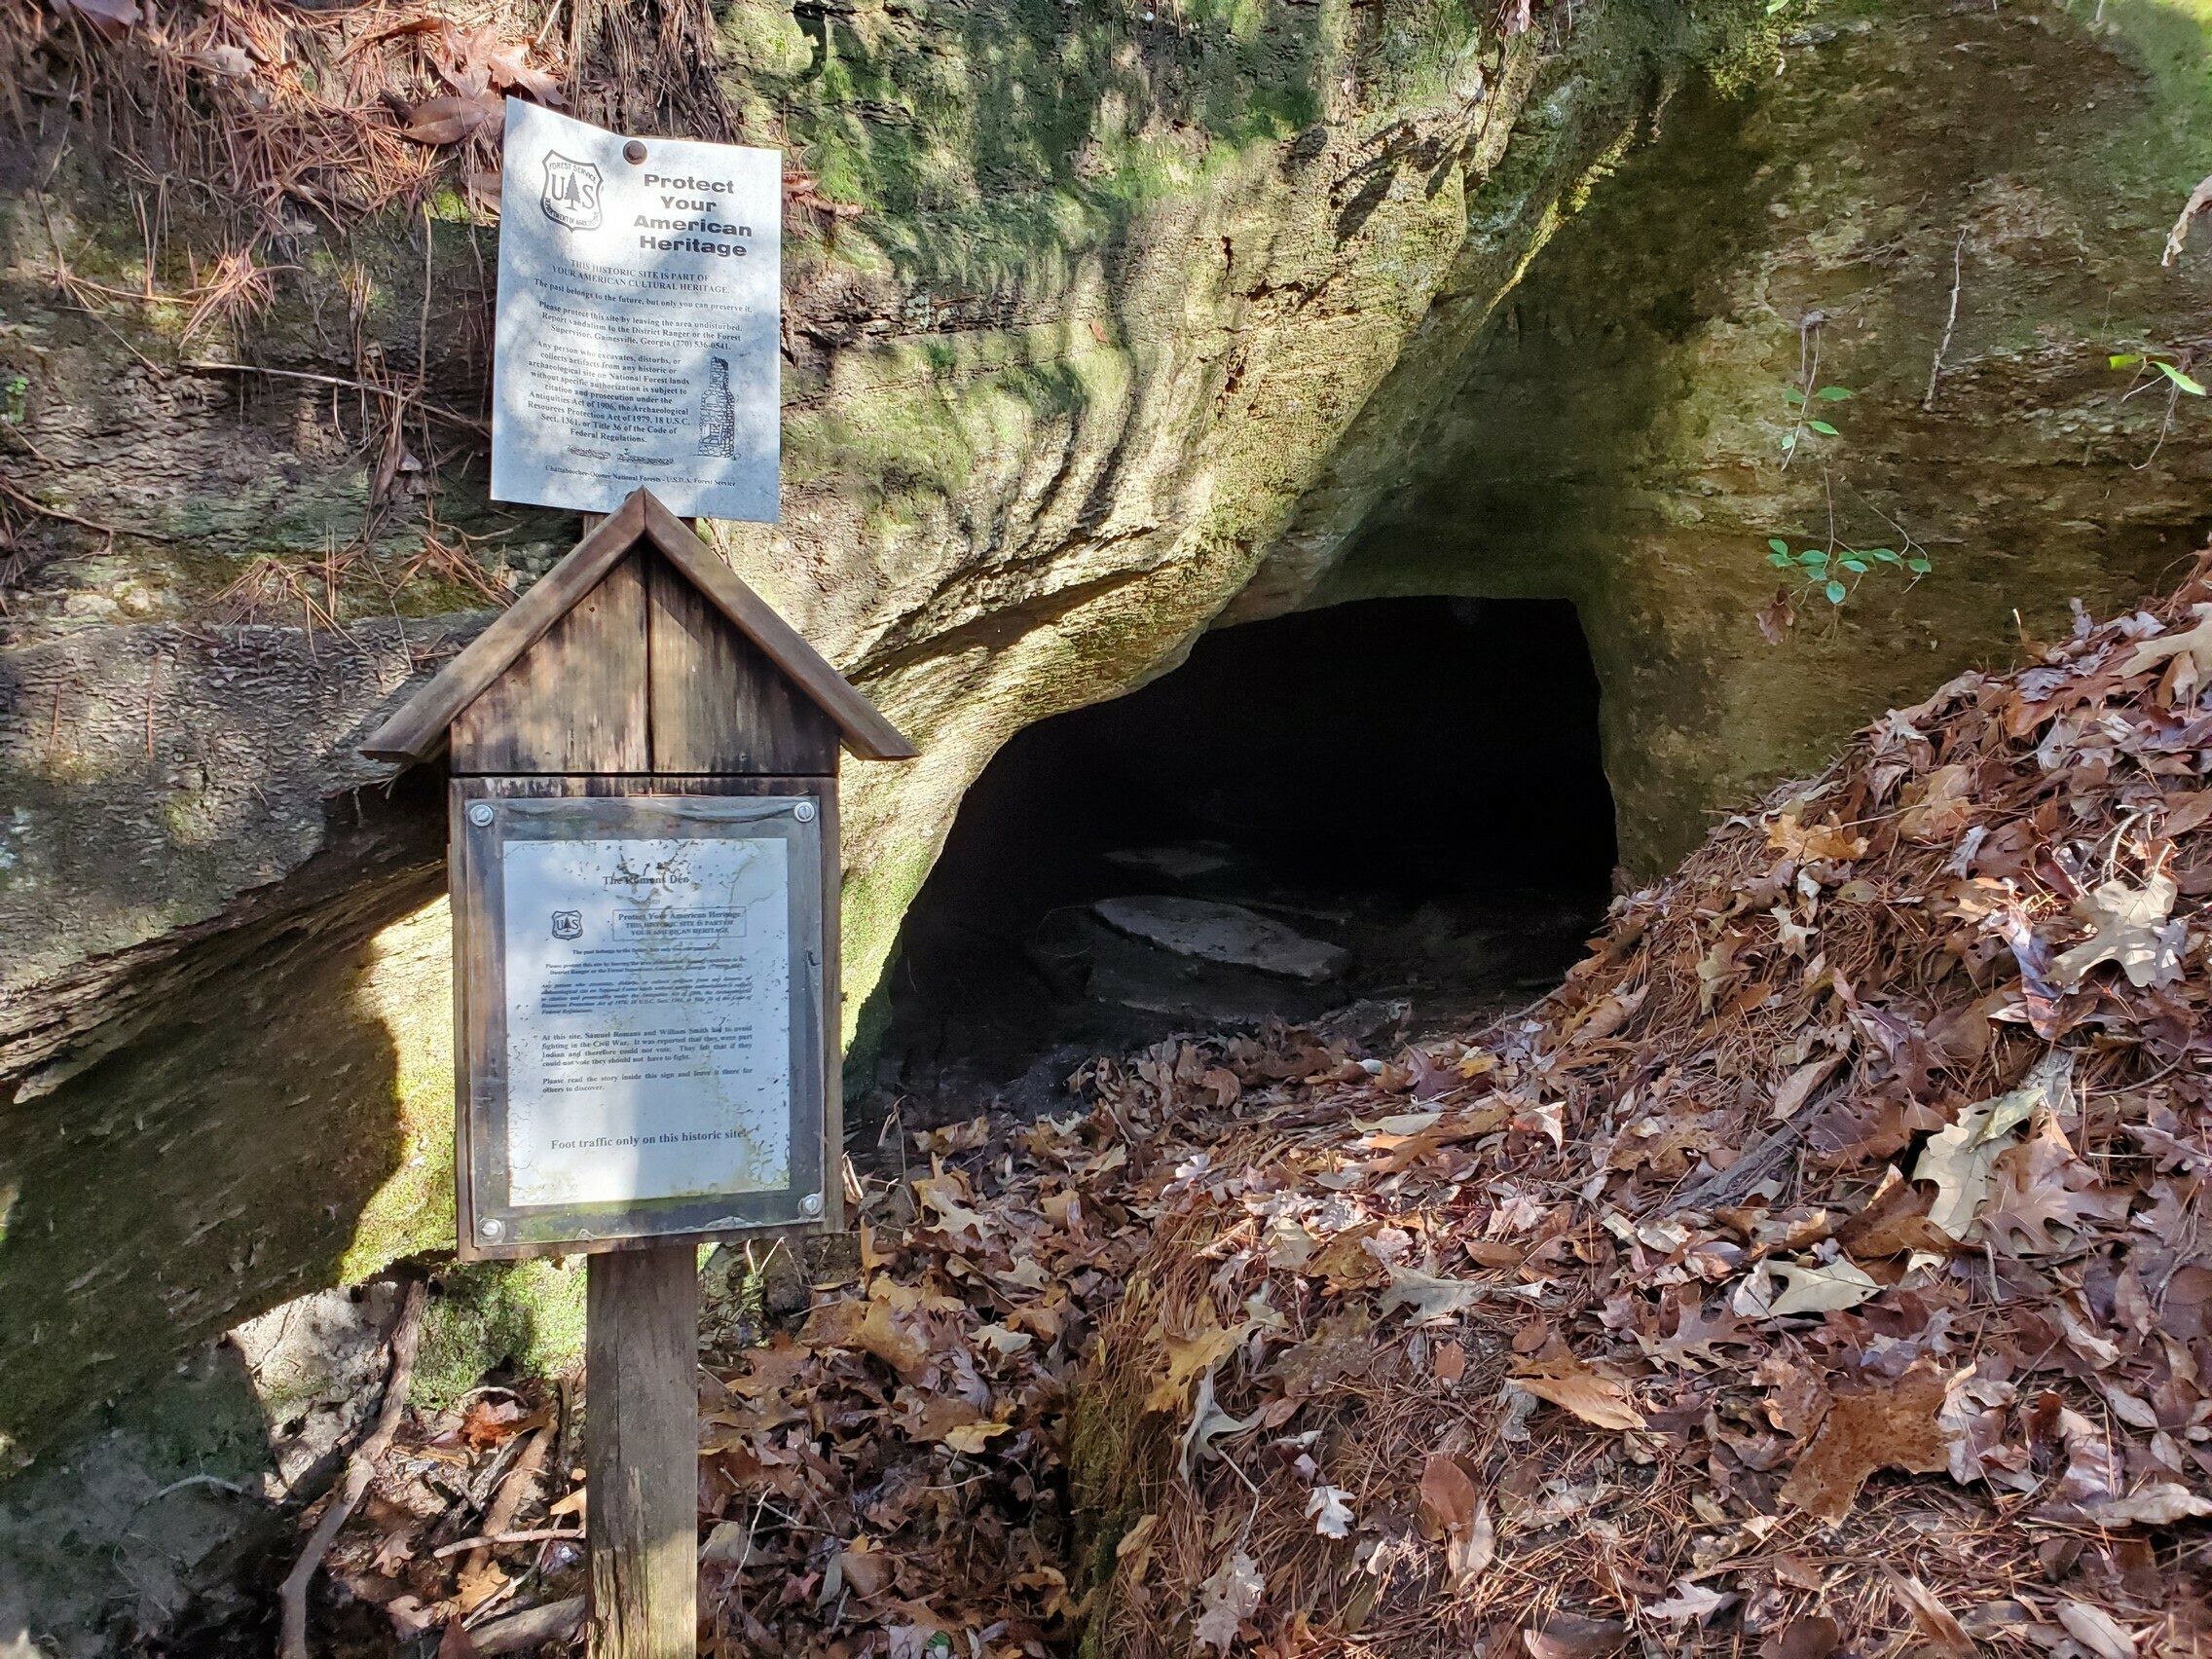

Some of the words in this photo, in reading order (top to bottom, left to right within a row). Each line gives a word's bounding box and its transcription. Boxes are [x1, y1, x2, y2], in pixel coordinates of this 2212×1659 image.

[644, 173, 734, 194] Protect
[660, 196, 717, 212] Your
[633, 215, 753, 237] American
[640, 236, 747, 258] Heritage
[552, 265, 576, 277] YOUR
[578, 273, 626, 285] AMERICAN
[628, 279, 677, 291] CULTURAL
[680, 283, 730, 294] HERITAGE.
[571, 260, 590, 270] THIS
[593, 265, 636, 277] HISTORIC
[638, 271, 659, 279] SITE
[671, 273, 696, 281] PART
[535, 278, 548, 288] The
[550, 283, 564, 292] past
[567, 287, 593, 299] belongs
[619, 295, 645, 305] future,
[661, 299, 677, 308] only
[538, 300, 561, 312] Please
[563, 308, 589, 318] protect
[632, 317, 660, 327] leaving
[542, 313, 567, 324] Report
[632, 327, 660, 335] District
[663, 330, 690, 338] Ranger
[717, 333, 741, 341] Forest
[537, 341, 551, 350] Any
[553, 345, 578, 354] person
[640, 337, 670, 347] Georgia
[673, 340, 692, 348] (770)
[541, 352, 567, 362] collects
[638, 365, 666, 373] historic
[531, 371, 559, 381] without
[590, 382, 640, 392] authorization
[609, 373, 641, 382] National
[644, 375, 667, 384] Forest
[529, 390, 570, 404] Antiquities
[632, 405, 689, 416] Archaeological
[545, 384, 572, 393] citation
[590, 392, 634, 401] prosecution
[528, 401, 565, 413] Resources
[567, 407, 605, 419] Protection
[570, 428, 598, 439] Federal
[600, 433, 647, 442] Regulations.
[593, 422, 610, 430] Title
[602, 874, 622, 885] The
[551, 1140, 575, 1149] Foot
[579, 1137, 613, 1148] traffic
[616, 1135, 640, 1147] only
[643, 1136, 656, 1144] on
[660, 1133, 679, 1143] this
[682, 1130, 721, 1142] historic
